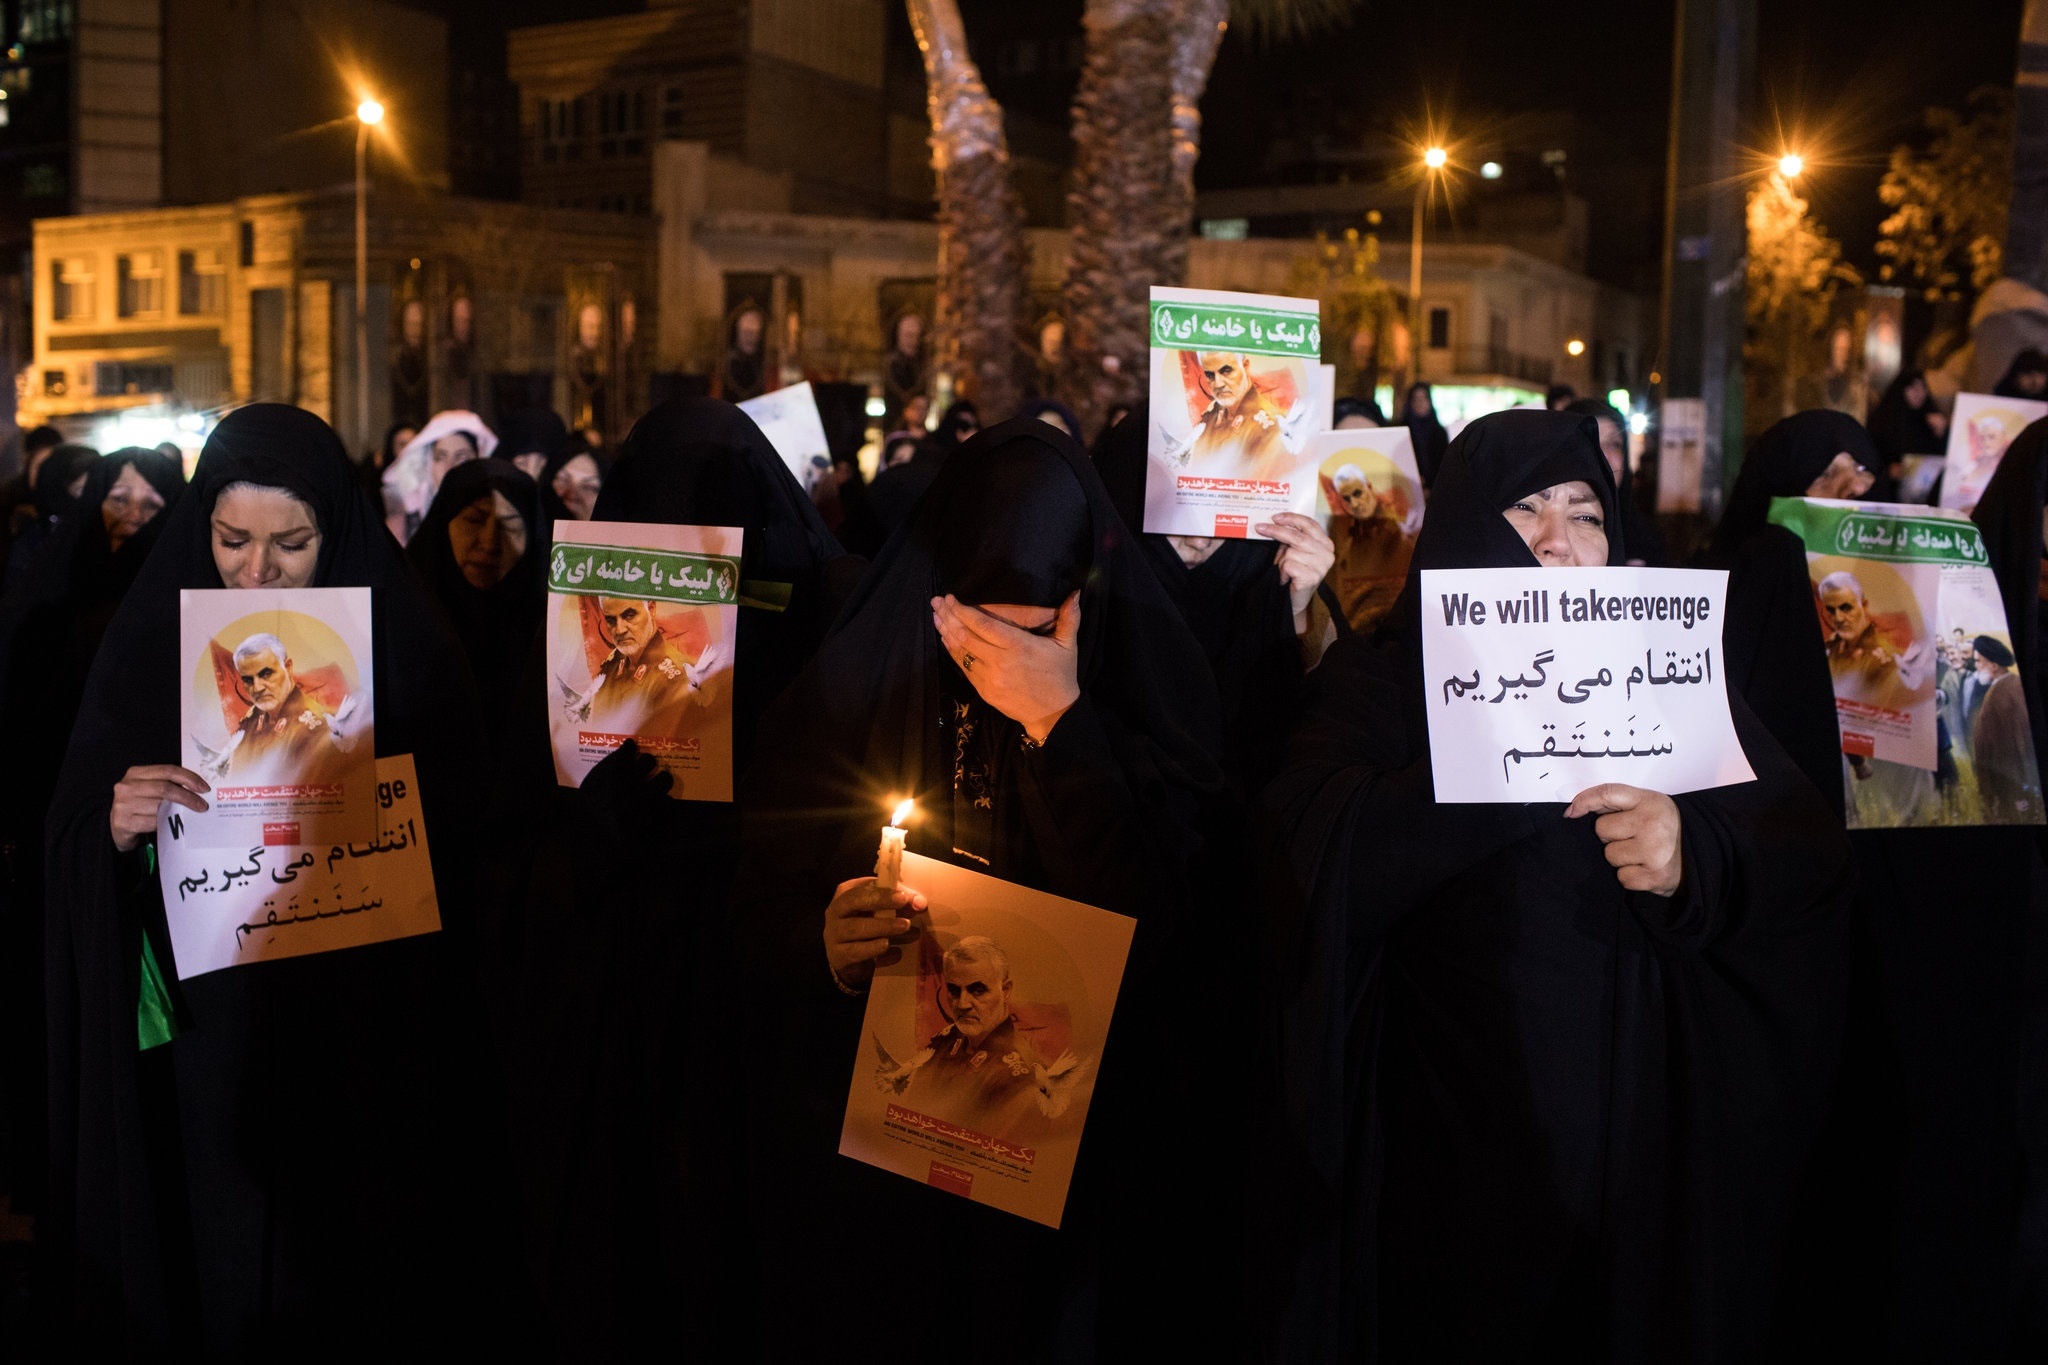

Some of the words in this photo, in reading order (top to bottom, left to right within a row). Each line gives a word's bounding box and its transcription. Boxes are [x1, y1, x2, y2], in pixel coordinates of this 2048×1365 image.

[1175, 314, 1197, 338] ای
[1202, 317, 1245, 337] خامنه
[1250, 319, 1262, 344] یا
[1267, 323, 1305, 349] لبیک
[567, 556, 593, 583] ای
[596, 559, 645, 582] خامنه
[650, 562, 663, 590] یا
[668, 566, 713, 595] لبیک
[1441, 593, 1486, 626] We
[1496, 590, 1548, 624] will
[1626, 648, 1711, 701] انتقام
[982, 1138, 1009, 1154] جهان
[1012, 1148, 1033, 1164] یک
